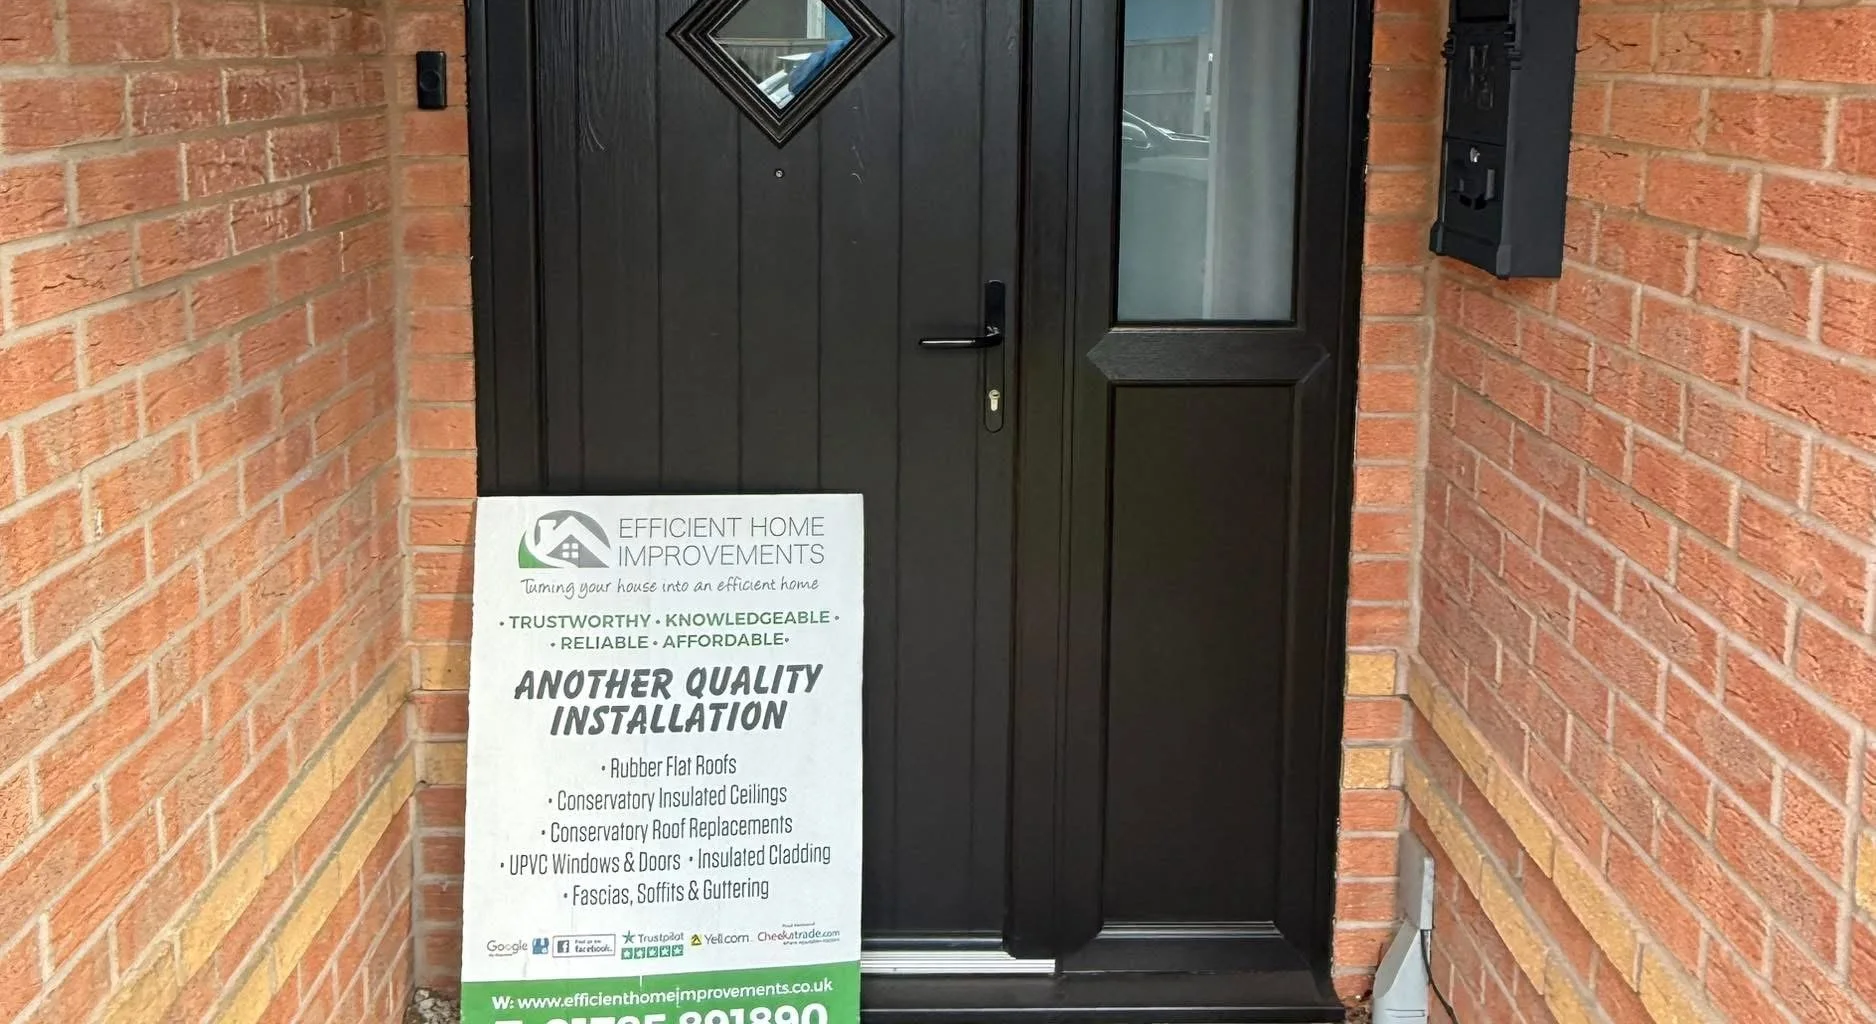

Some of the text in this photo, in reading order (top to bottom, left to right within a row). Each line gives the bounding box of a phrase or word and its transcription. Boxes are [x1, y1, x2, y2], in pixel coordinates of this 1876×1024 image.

[619, 516, 824, 539] EFFICIENT HOME
[618, 544, 825, 567] IMPROVEMENTS
[521, 577, 819, 599] Turning your house into an efficient home
[509, 611, 830, 629] TRUSTWORTHY KNOWLEDGEABLE
[561, 633, 783, 649] RELIABLE AFFORDABLE
[514, 664, 824, 699] ANOTHER QUALITY
[550, 700, 787, 735] INSTALLATION
[611, 753, 737, 778] Rubber Flat Roofs
[557, 784, 787, 812] Conservatory Insulated Ceilings
[550, 816, 793, 843] Conservatory Roof Replacements
[509, 843, 831, 875] UPVC Windows & Doors Insulated Cladding
[573, 878, 769, 906] Fascias, Soffits & Guttering
[486, 940, 528, 956] Google
[492, 995, 514, 1010] W:
